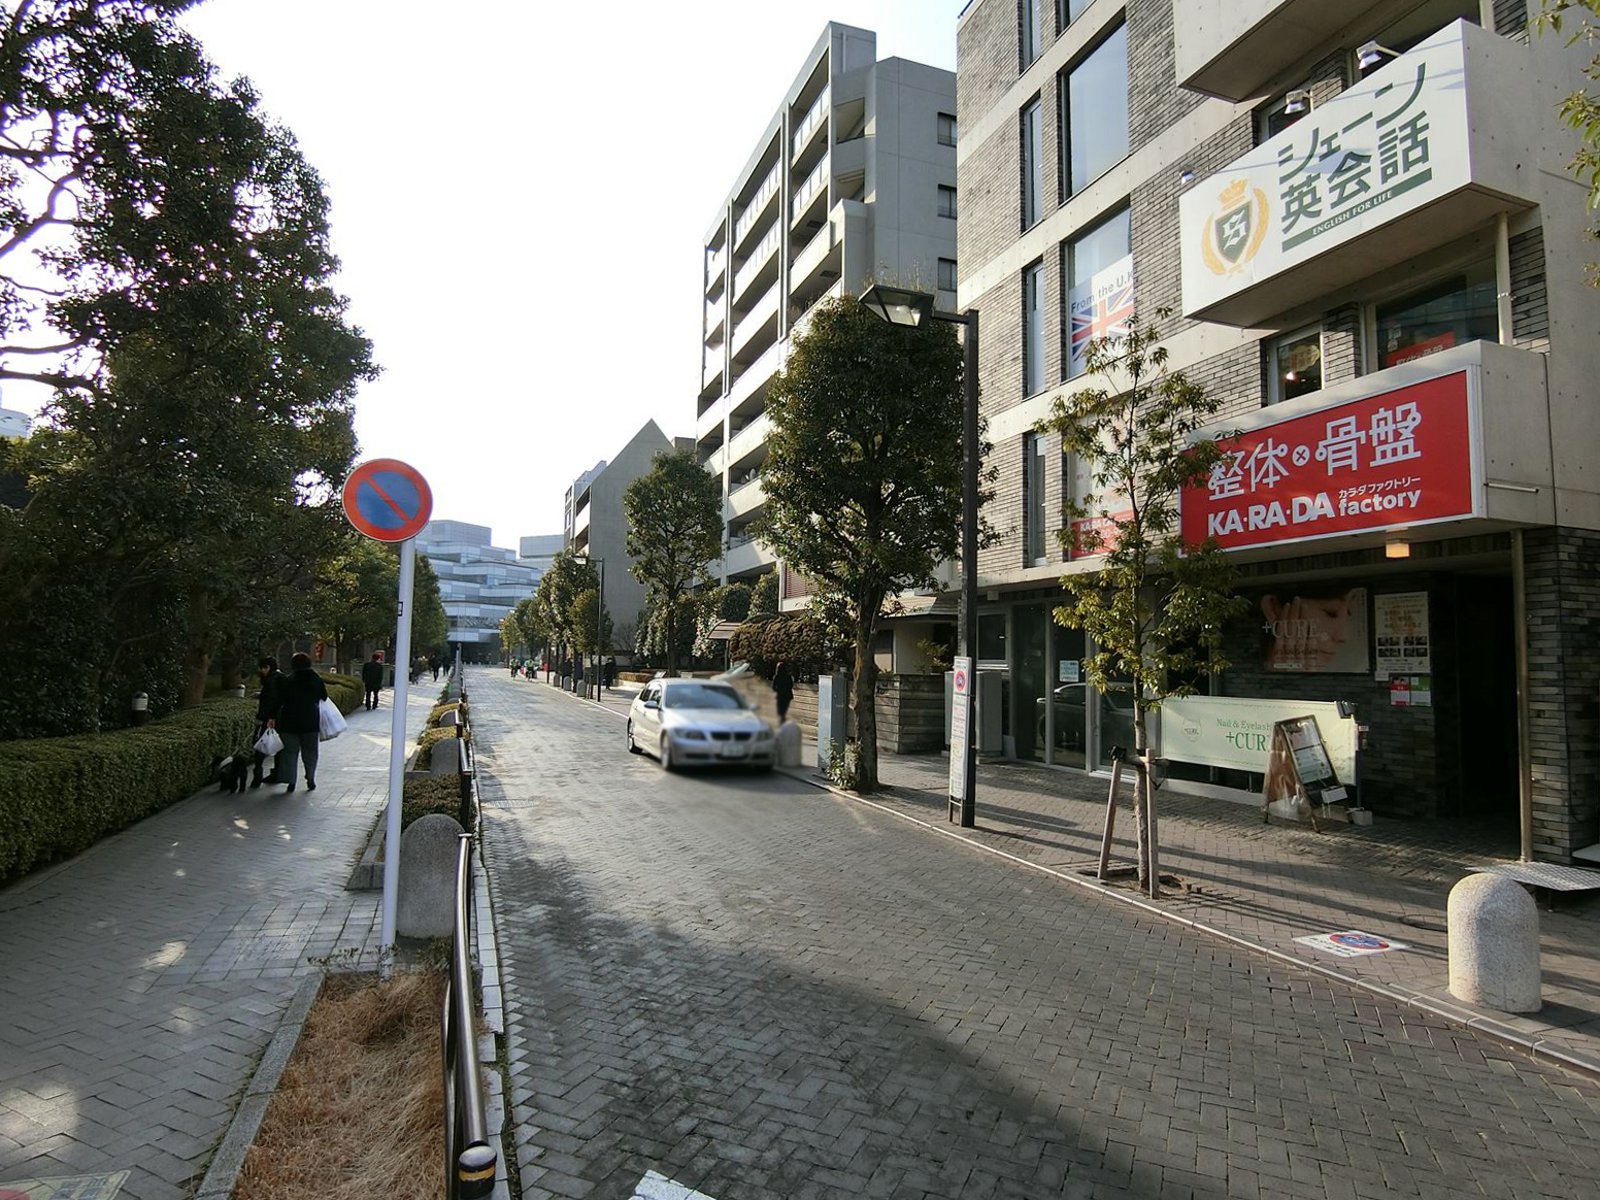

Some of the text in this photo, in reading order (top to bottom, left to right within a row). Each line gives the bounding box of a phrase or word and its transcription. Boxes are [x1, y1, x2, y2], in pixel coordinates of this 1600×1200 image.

[1278, 62, 1426, 185] シェーン
[1280, 110, 1429, 234] 英会話
[1312, 191, 1392, 235] ENGLISH FOR LIFE
[1071, 295, 1095, 314] From
[1098, 284, 1114, 298] the
[1338, 489, 1422, 517] factory
[1339, 476, 1421, 499] カラダファクトリー
